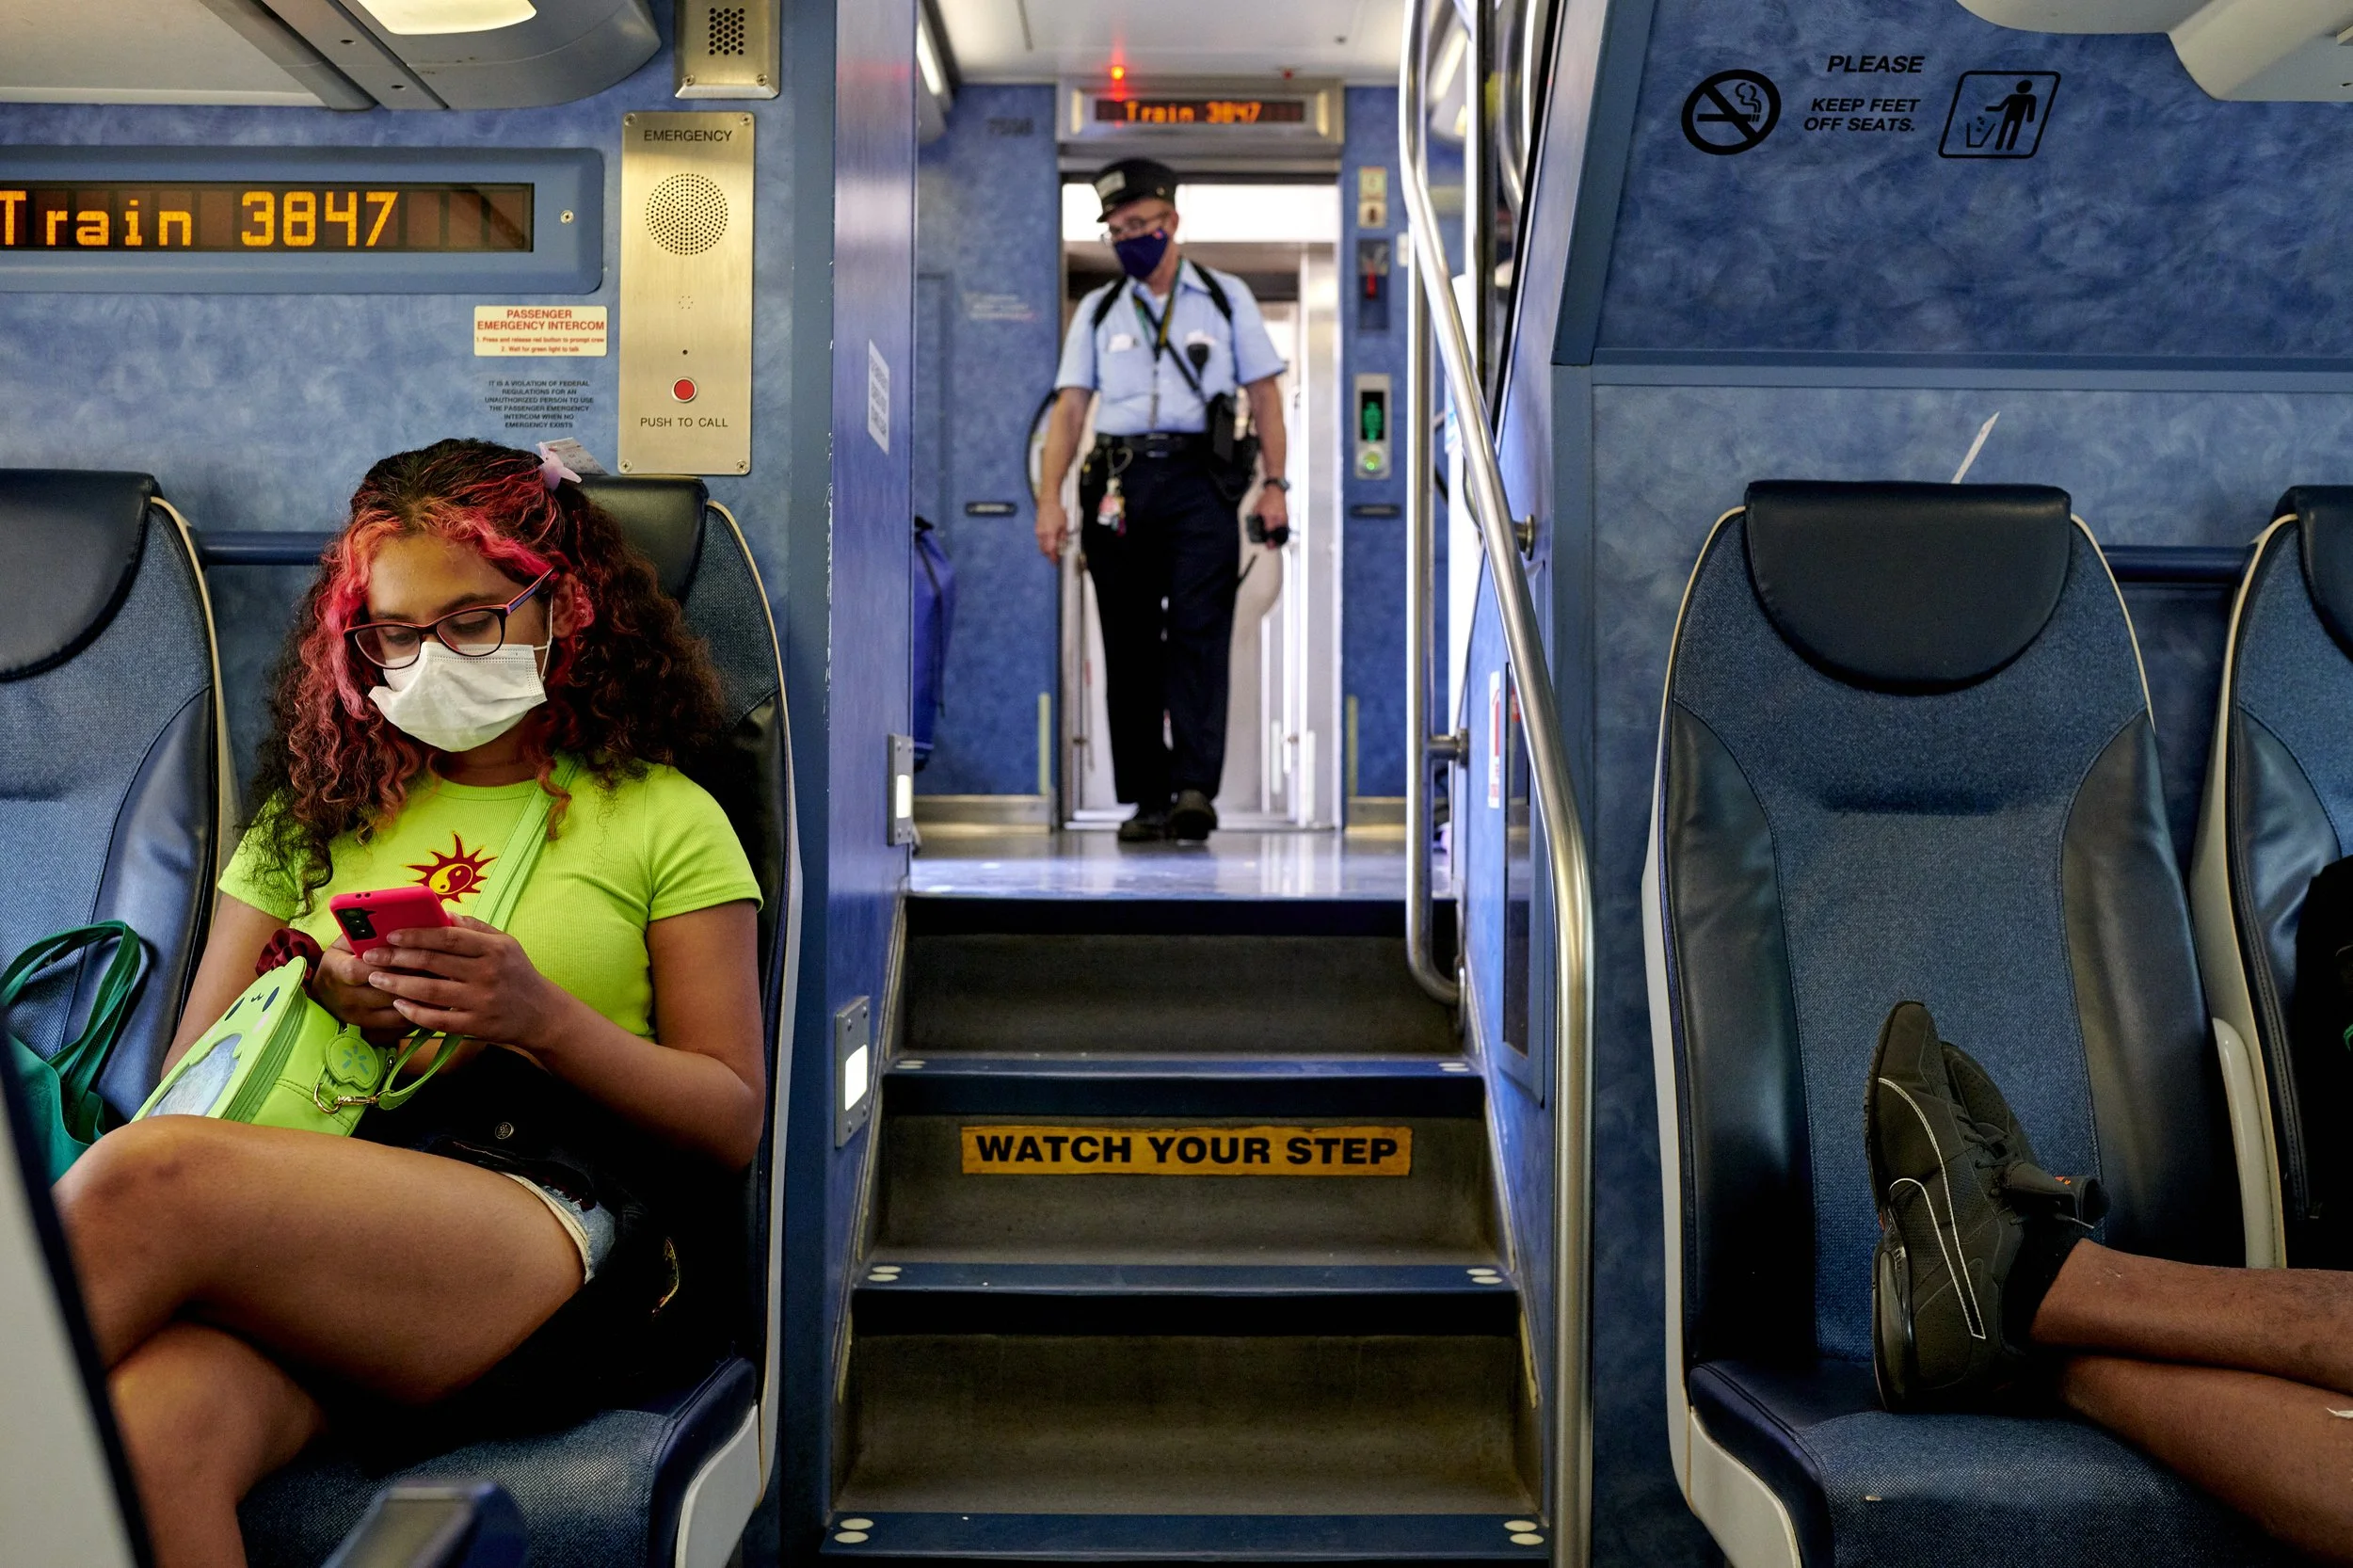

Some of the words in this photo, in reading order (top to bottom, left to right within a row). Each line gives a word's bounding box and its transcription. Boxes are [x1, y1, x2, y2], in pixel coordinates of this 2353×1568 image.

[1827, 56, 1925, 73] PLEASE
[1126, 101, 1194, 123] Train
[1811, 98, 1865, 112] KEEP
[1869, 99, 1921, 112] FEET
[1803, 118, 1843, 131] OFF
[1847, 118, 1915, 132] SEATS.
[644, 130, 732, 142] EMERGENCY
[0, 190, 192, 246] Train
[241, 191, 398, 247] 3847
[506, 309, 572, 319] PASSENGER
[477, 321, 546, 330] EMERGENCY
[548, 321, 604, 330] INTERCOM
[640, 417, 672, 427] PUSH
[677, 417, 694, 427] TO
[698, 417, 728, 427] CALL
[976, 1136, 1131, 1162] WATCH
[1148, 1137, 1271, 1163] YOUR
[1287, 1137, 1398, 1164] STEP
